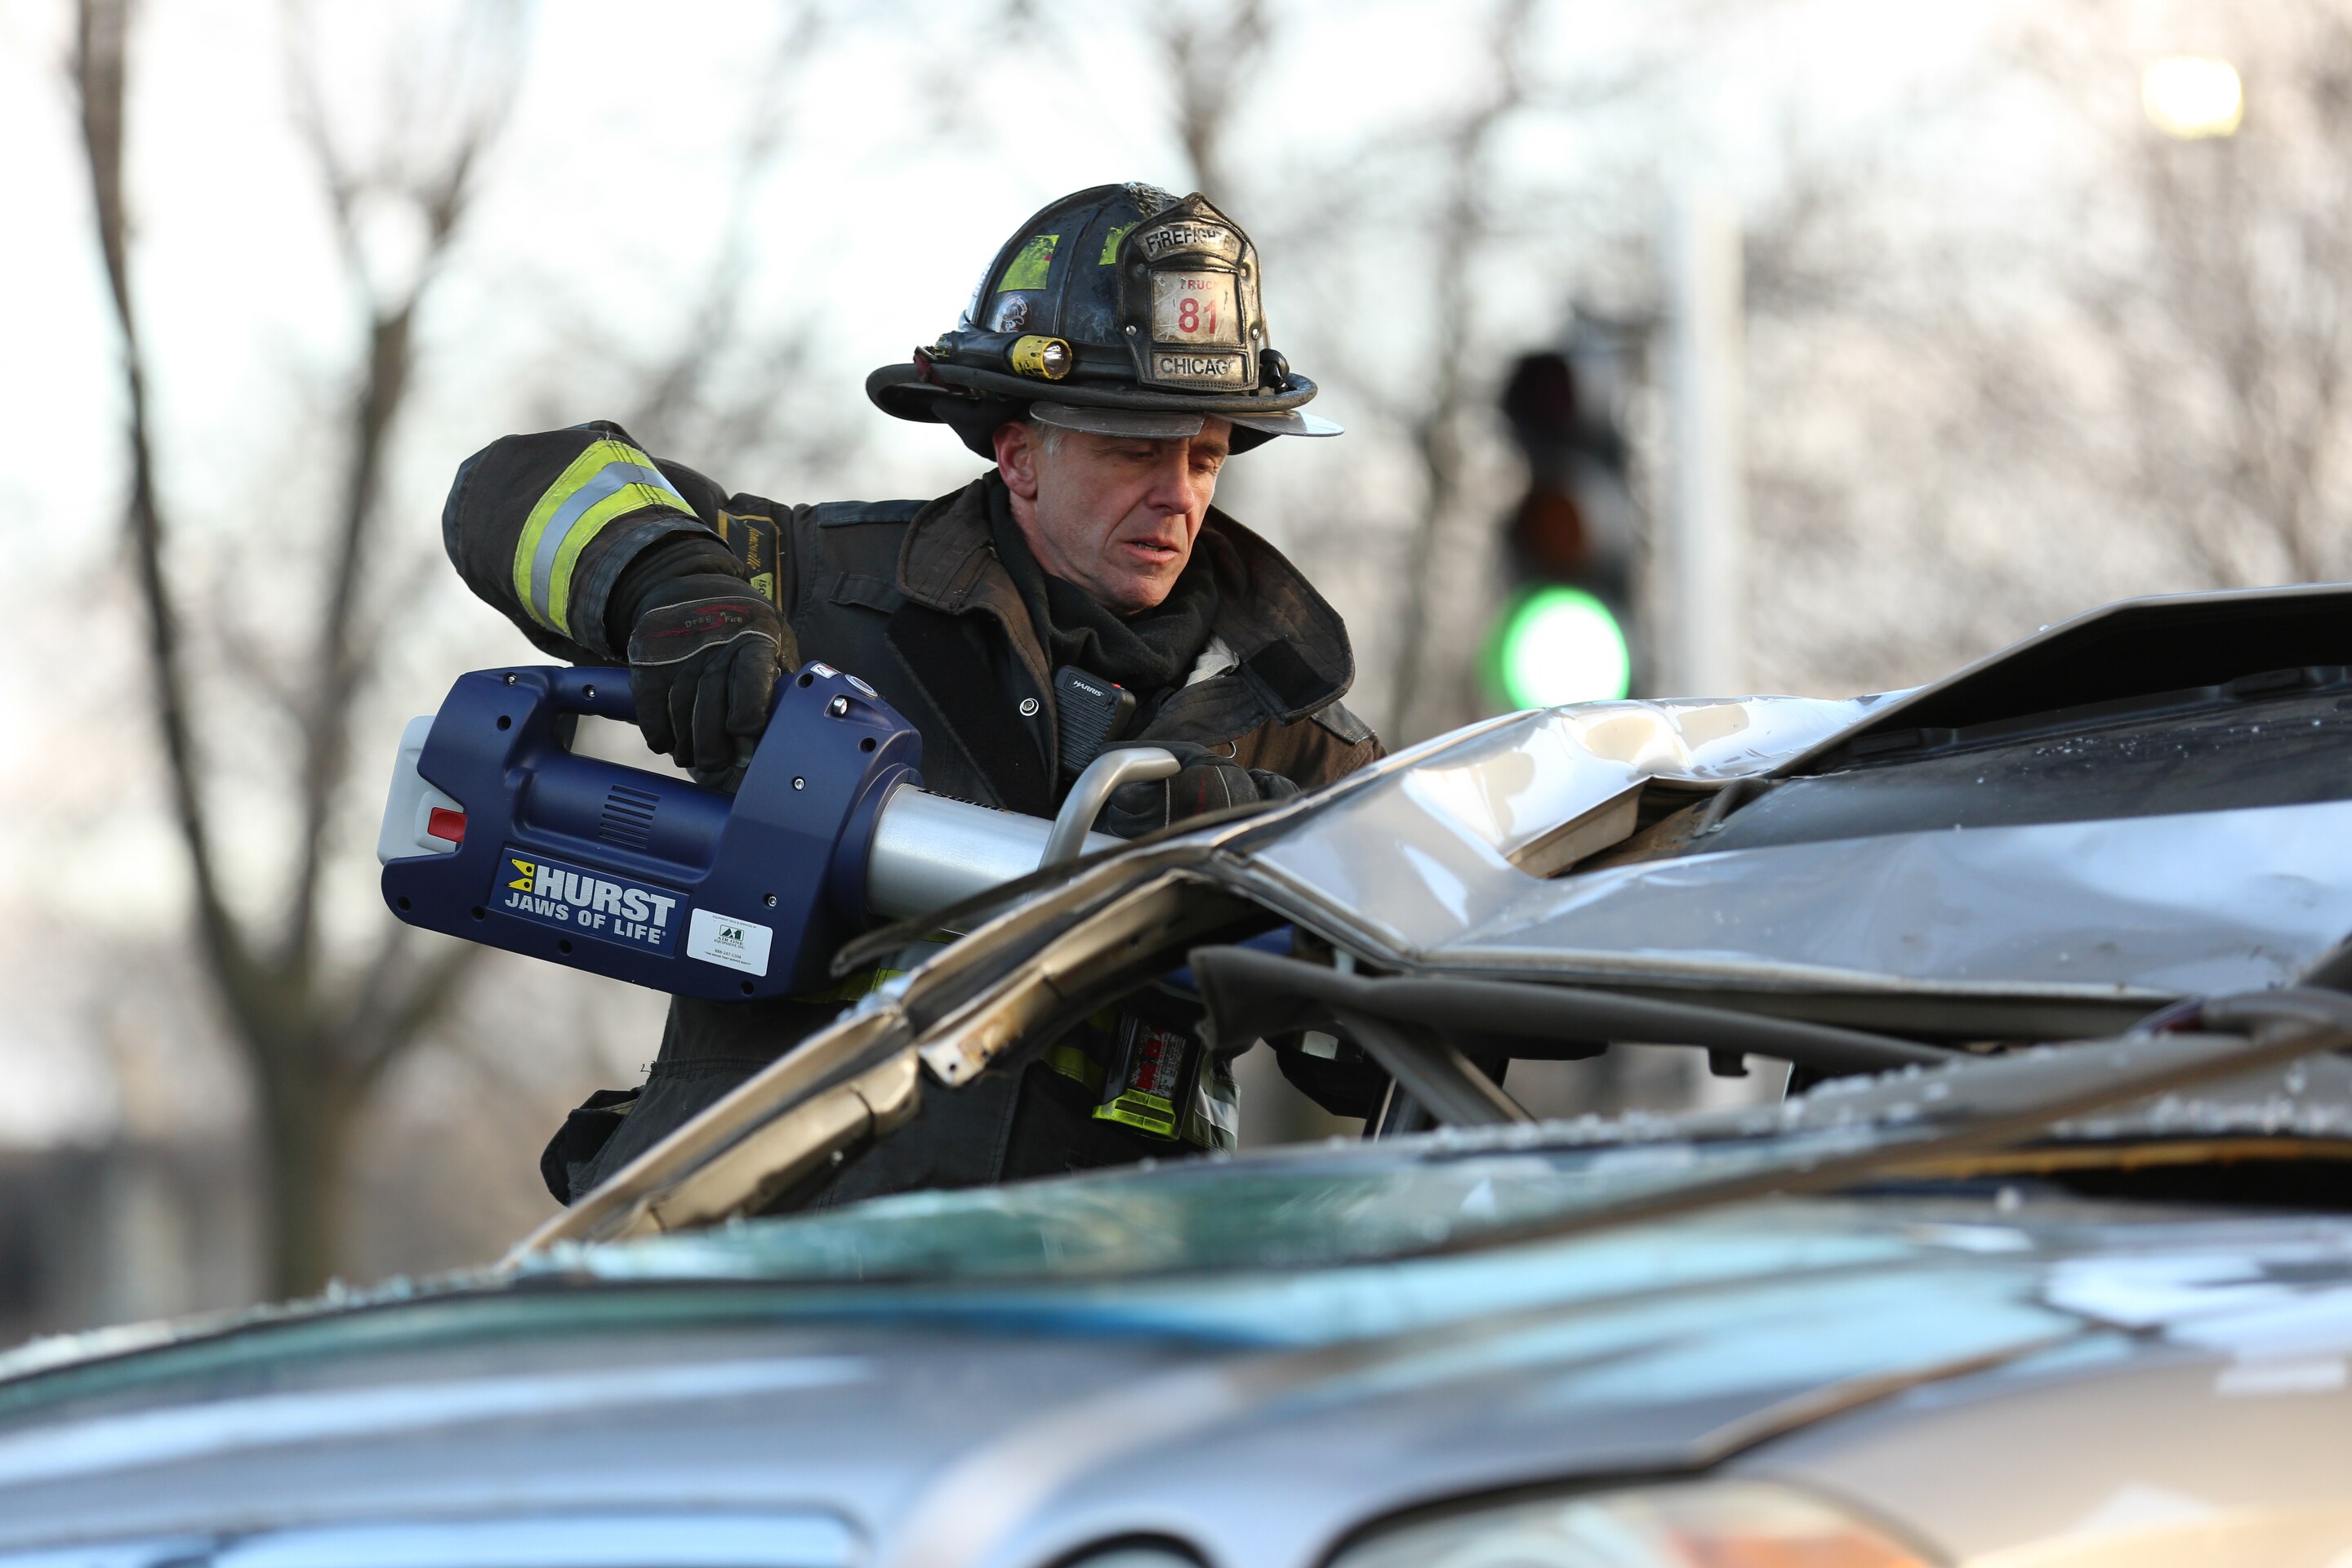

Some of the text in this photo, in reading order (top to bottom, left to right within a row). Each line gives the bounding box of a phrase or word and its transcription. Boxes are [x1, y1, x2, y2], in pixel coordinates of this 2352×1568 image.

[1179, 298, 1216, 334] 81
[1160, 358, 1232, 375] CHICAG
[1073, 680, 1102, 696] HARRIS
[505, 892, 569, 921] JAWS
[577, 910, 607, 929] OF
[534, 865, 676, 928] HURST
